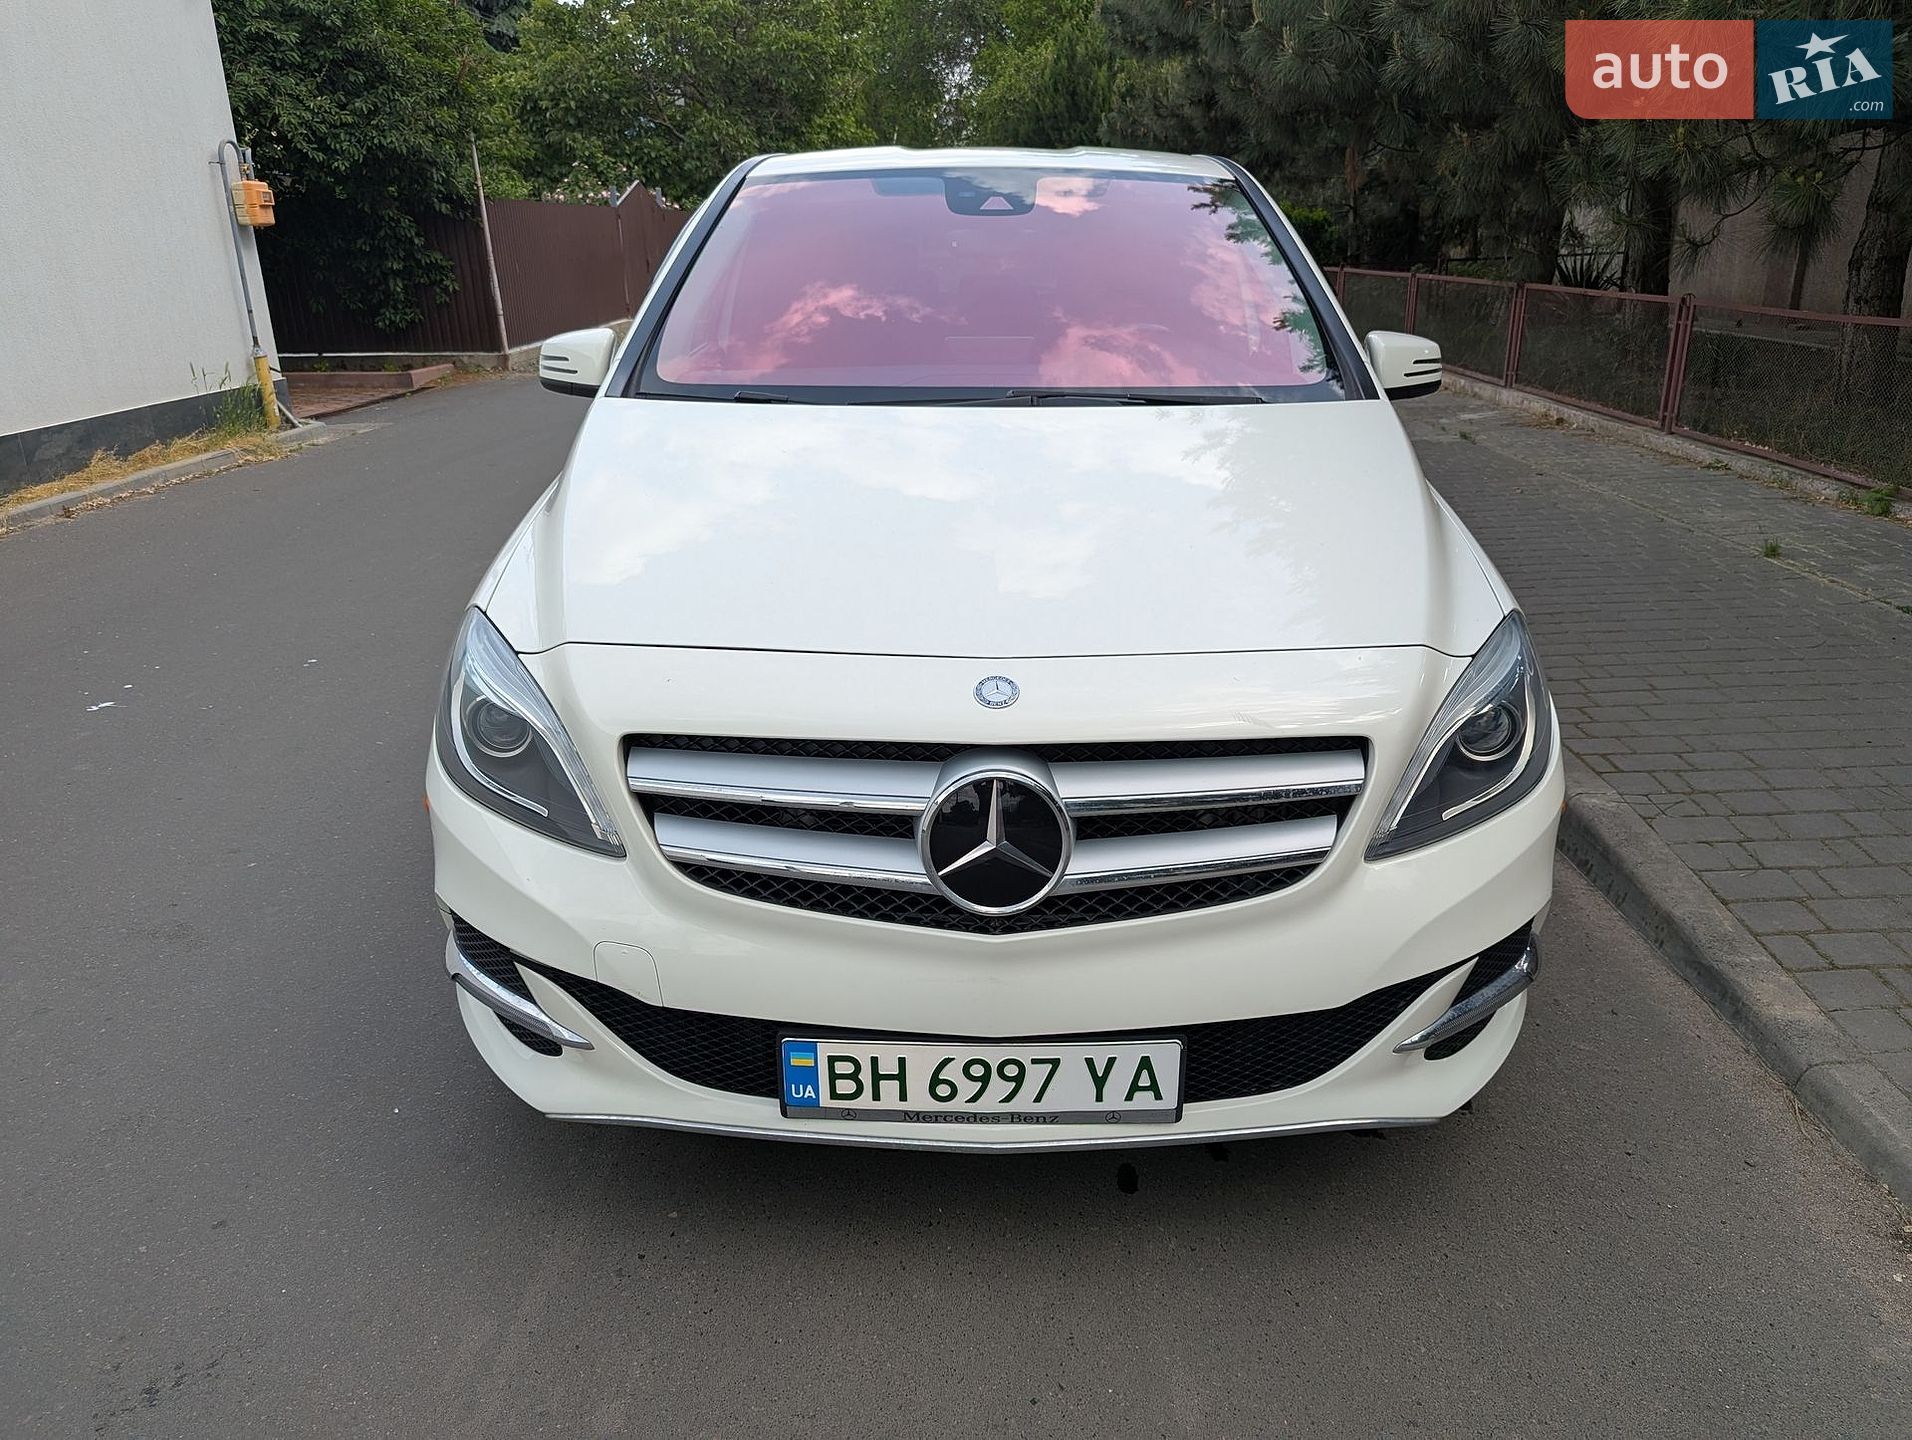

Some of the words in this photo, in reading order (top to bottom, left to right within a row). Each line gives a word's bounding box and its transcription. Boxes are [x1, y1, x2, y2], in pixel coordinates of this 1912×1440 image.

[826, 1054, 908, 1102] BH
[928, 1056, 1061, 1104] 6997
[1083, 1054, 1164, 1102] YA
[791, 1083, 817, 1099] UA
[902, 1110, 1060, 1125] Mercedes-Benz
